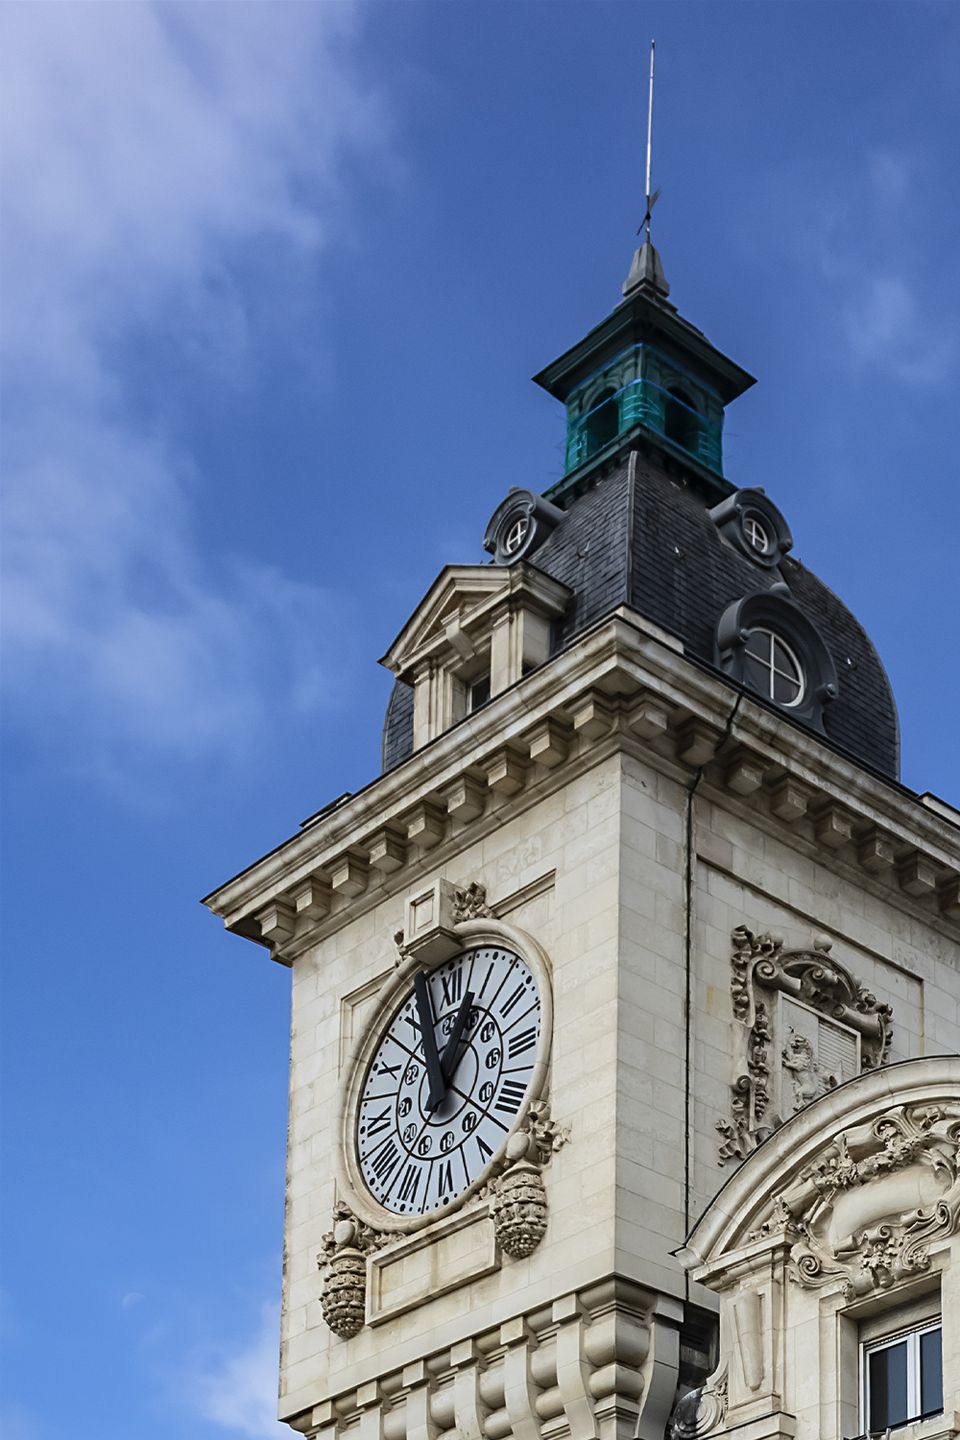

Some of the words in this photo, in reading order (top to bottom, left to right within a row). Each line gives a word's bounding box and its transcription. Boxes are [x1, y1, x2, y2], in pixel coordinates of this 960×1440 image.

[440, 967, 462, 1010] XII
[499, 982, 527, 1018] II
[483, 1023, 494, 1040] 14
[508, 1026, 536, 1059] III
[487, 1050, 499, 1068] 15
[377, 1061, 402, 1080] X
[406, 1066, 418, 1084] 22
[481, 1083, 493, 1101] 16
[399, 1100, 410, 1116] 21
[367, 1105, 392, 1137] IX
[464, 1114, 475, 1130] 17
[404, 1126, 417, 1142] 20
[442, 1134, 454, 1150] 18
[420, 1137, 432, 1154] 19
